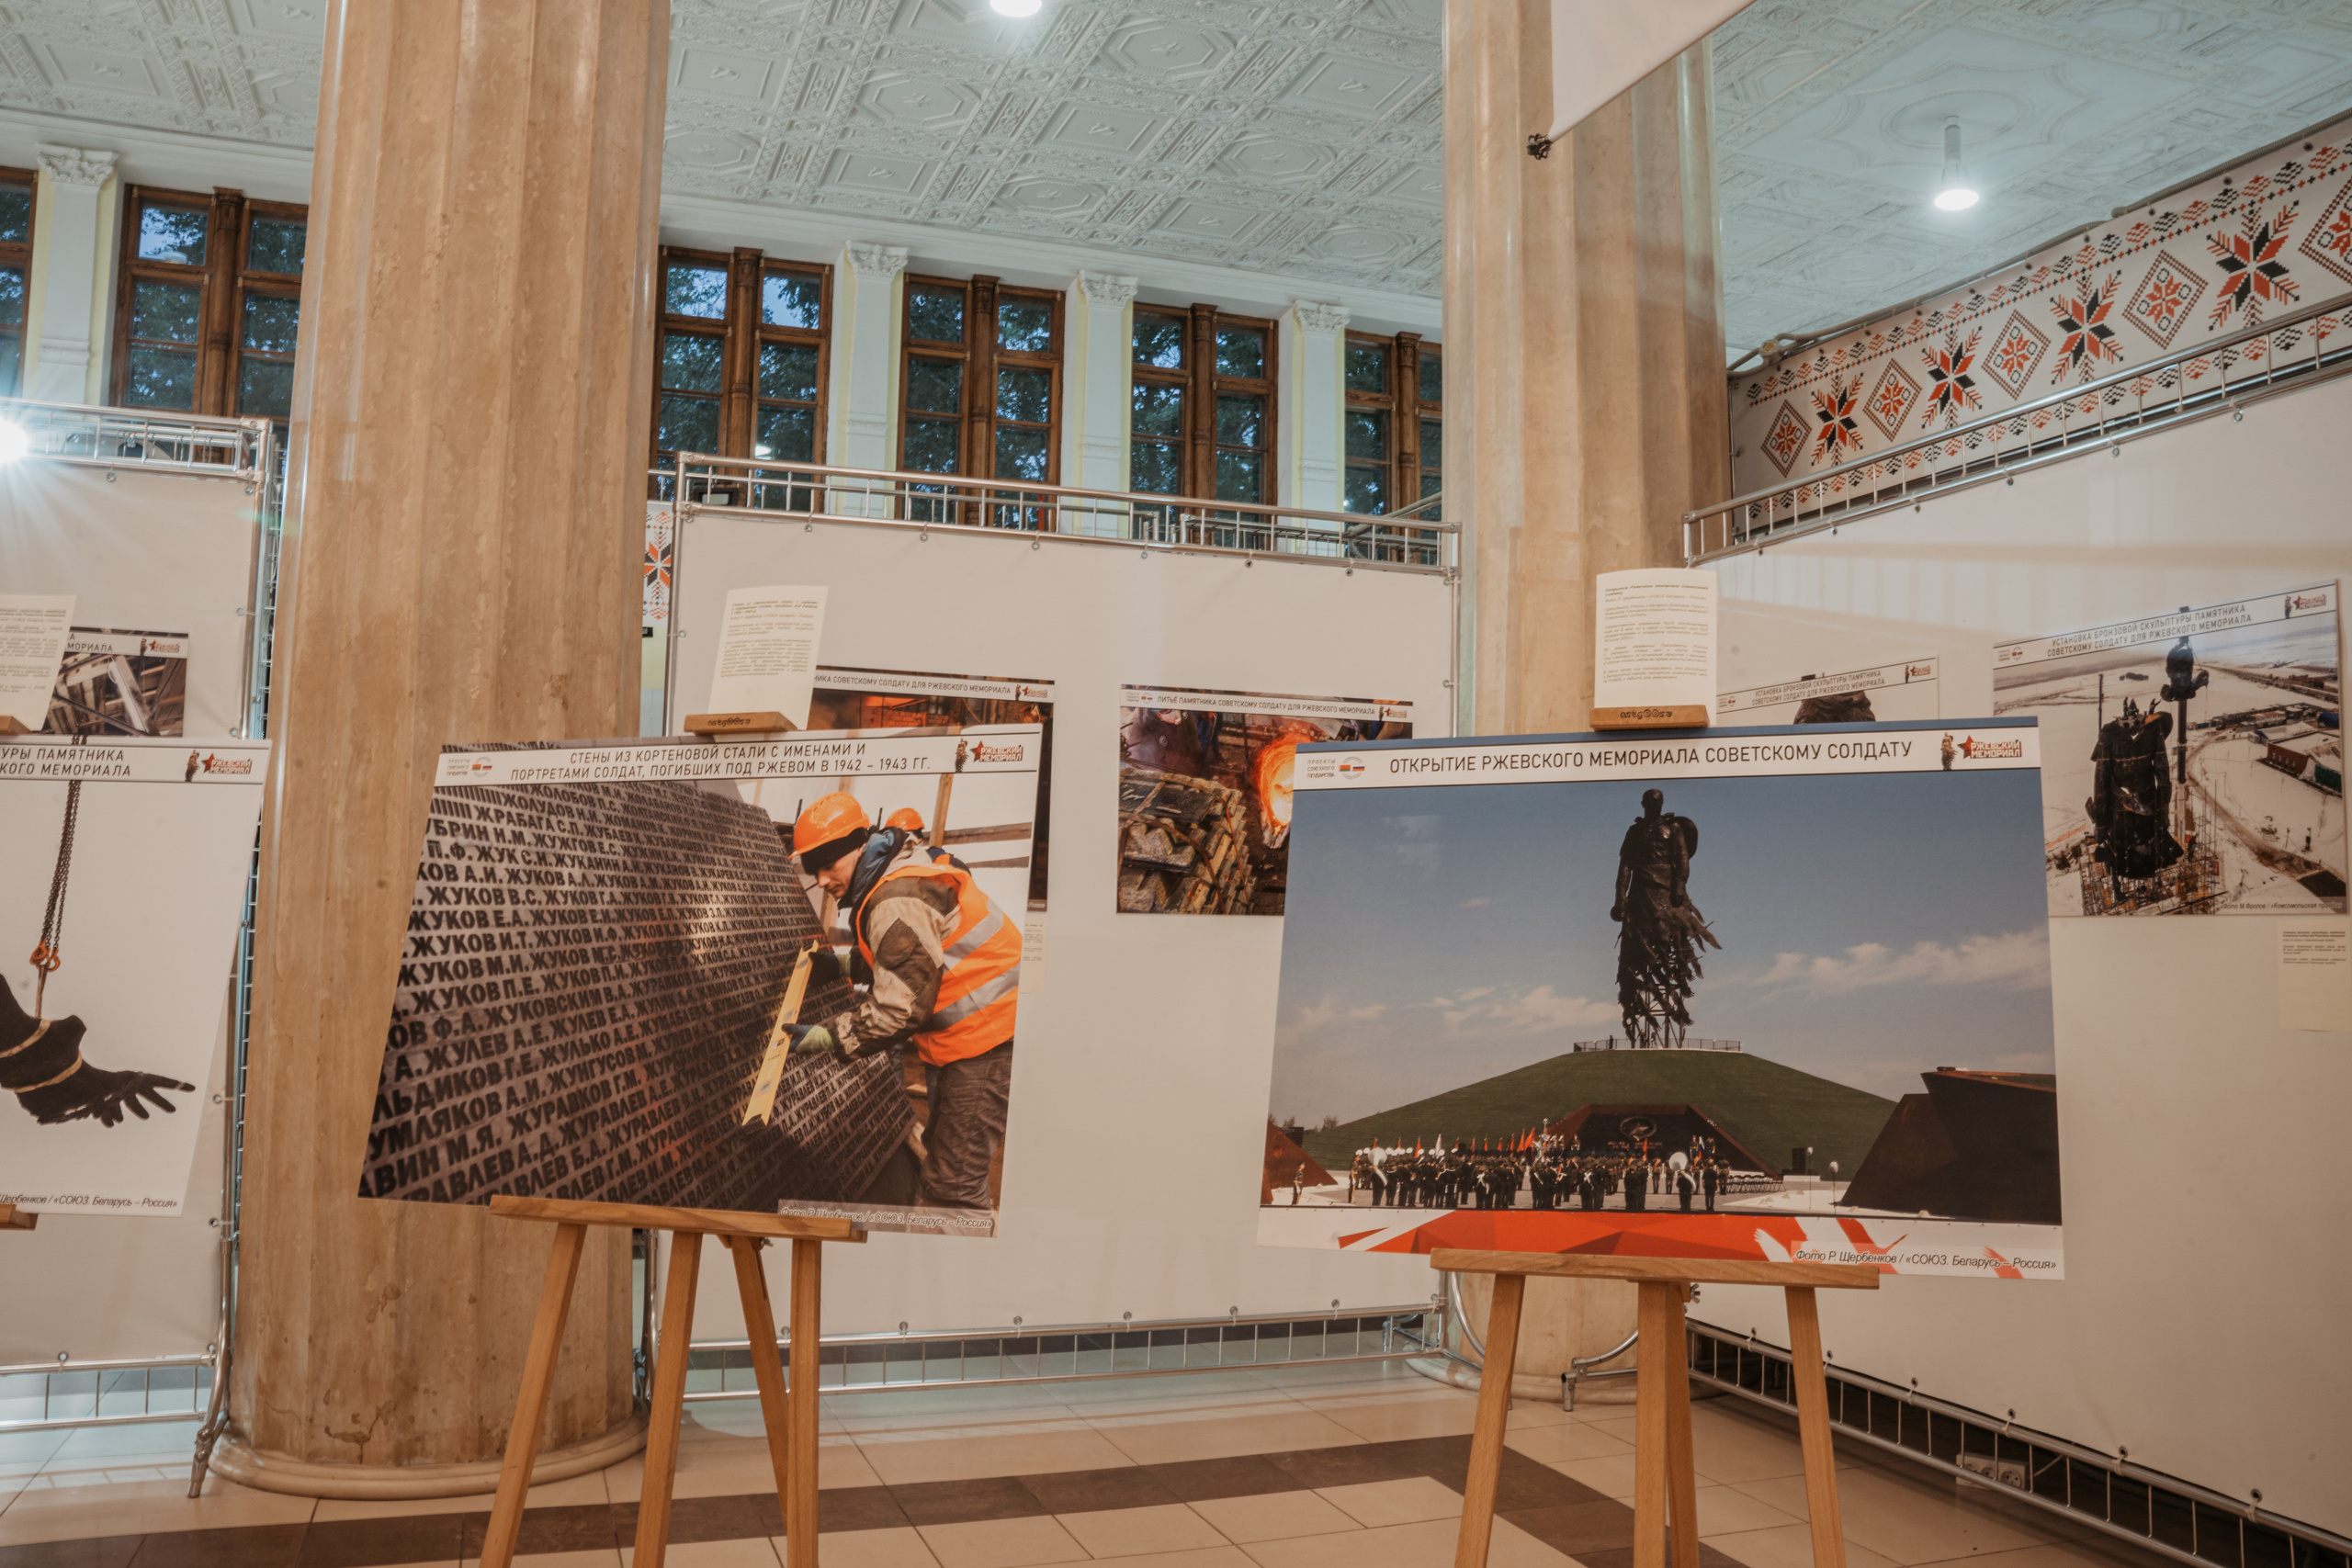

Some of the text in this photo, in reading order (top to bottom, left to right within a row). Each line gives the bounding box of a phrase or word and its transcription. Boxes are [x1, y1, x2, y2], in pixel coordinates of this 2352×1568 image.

[2048, 613, 2252, 658] СОВЕТСКОМУ СОЛДАТУ ДЛЯ РЖЕВСКОГО МЕМОРИАЛА
[2052, 604, 2245, 647] УСТАНОВКА БРОНЗОВОЙ СКУЛЬПТУРЫ ПАМЯТНИКА
[833, 676, 876, 686] СОВЕТСКОМУ
[878, 679, 910, 688] СОЛДАТУ
[911, 681, 926, 690] ДЛЯ
[928, 682, 968, 692] РЖЕВСКОГО
[970, 684, 1011, 694] МЕМОРИАЛА
[1179, 697, 1216, 707] ПАМЯТНИКА
[1218, 700, 1258, 709] СОВЕТСКОМУ
[1259, 702, 1286, 711] СОЛДАТУ
[1287, 704, 1301, 712] ДЛЯ
[1302, 705, 1338, 714] РЖЕВСКОГО
[1339, 706, 1375, 716] МЕМОРИАЛА
[37, 749, 125, 762] ПАМЯТНИКА
[570, 742, 865, 763] СТЕНЫ ИЗ КОРТЕНОВОЙ СТАЛИ С ИМЕНАМИ И
[980, 745, 1023, 755] РЖЕВСКИЙ
[1970, 739, 2022, 751] РЖЕВСКИЙ
[1970, 749, 2022, 760] МЕМОРИАЛ
[979, 752, 1023, 762] МЕМОРИАЛ
[1389, 740, 1913, 773] ОТКРЫТИЕ РЖЕВСКОГО МЕМОРИАЛА СОВЕТСКОМУ СОЛДАТУ
[0, 762, 131, 777] КОГО МЕМОРИАЛА
[511, 768, 589, 781] ПОРТРЕТАМИ
[594, 765, 645, 779] СОЛДАТ,
[650, 762, 720, 777] ПОГИБШИХ
[726, 761, 752, 776] ПОД
[758, 760, 815, 773] РЖЕВОМ
[820, 760, 829, 773] В
[835, 759, 861, 773] 1942
[879, 757, 908, 771] 1943
[913, 757, 931, 770] ГГ.
[473, 805, 555, 832] ЖРАБАГА
[474, 844, 520, 864] ЖУК
[464, 865, 503, 885] А.И.
[503, 867, 566, 887] ЖУКОВ
[425, 886, 599, 907] ЖУКОВ В.С. ЖУКОВ
[407, 909, 590, 931] ЖУКОВ Е.А. ЖУКОВ
[410, 933, 497, 958] ЖУКОВ
[498, 931, 533, 951] И.Т.
[533, 928, 593, 949] ЖУКОВ
[397, 949, 588, 988] ЖУКОВ М.И. ЖУКОВ
[410, 968, 601, 1015] ЖУКОВ П.Е. ЖУКОВ
[424, 1032, 509, 1075] ЖУЛЕВ
[92, 1196, 132, 1209] Беларусь
[141, 1198, 177, 1208] Россия»
[907, 1213, 947, 1228] Беларусь
[956, 1216, 993, 1229] Россия»
[1795, 1249, 1826, 1263] Фото
[1827, 1250, 1837, 1262] Р.
[1838, 1250, 1897, 1266] Щербенков
[1905, 1253, 1949, 1266] «СОЮЗ.
[1952, 1255, 2001, 1269] Беларусь
[2012, 1258, 2056, 1269] Россия»
